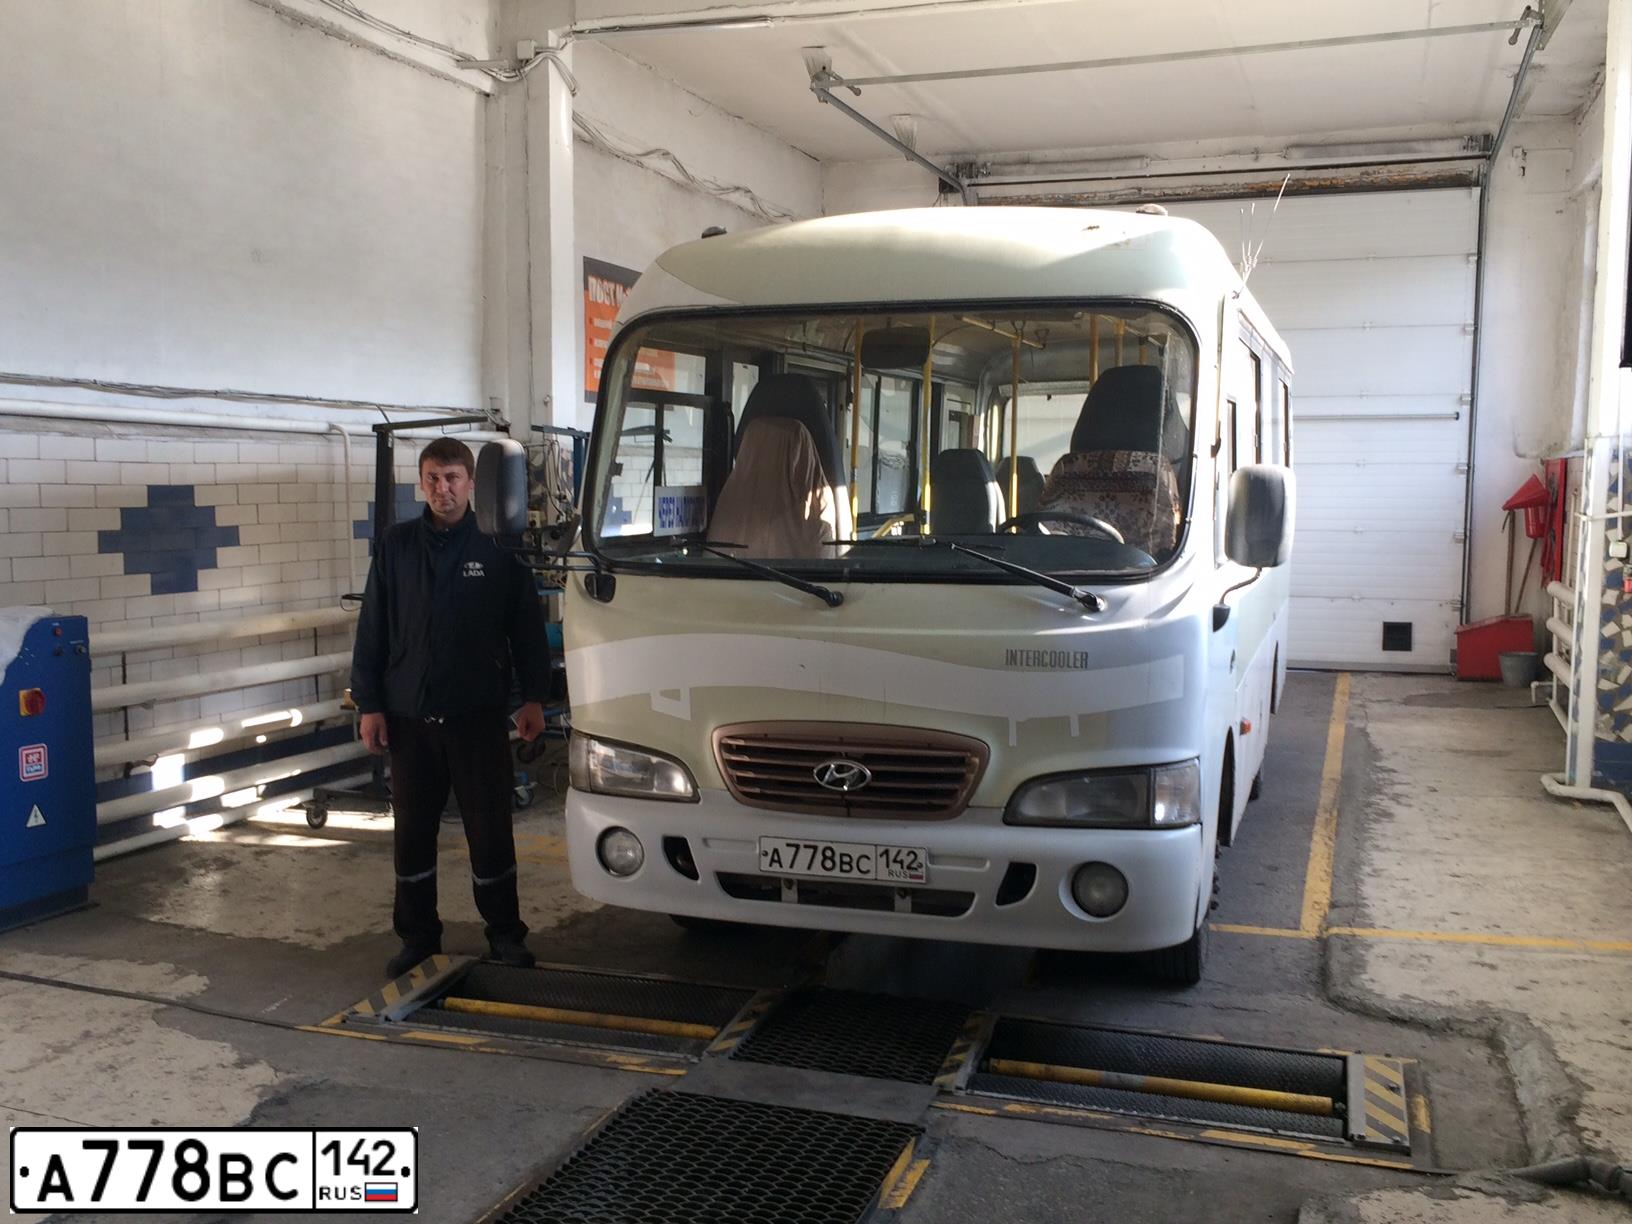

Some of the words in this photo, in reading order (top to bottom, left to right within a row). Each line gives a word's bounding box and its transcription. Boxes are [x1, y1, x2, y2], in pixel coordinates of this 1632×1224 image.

[463, 569, 485, 577] LADA
[1005, 649, 1088, 669] INTERCOOLER
[879, 848, 919, 871] 142
[888, 870, 909, 879] RUS
